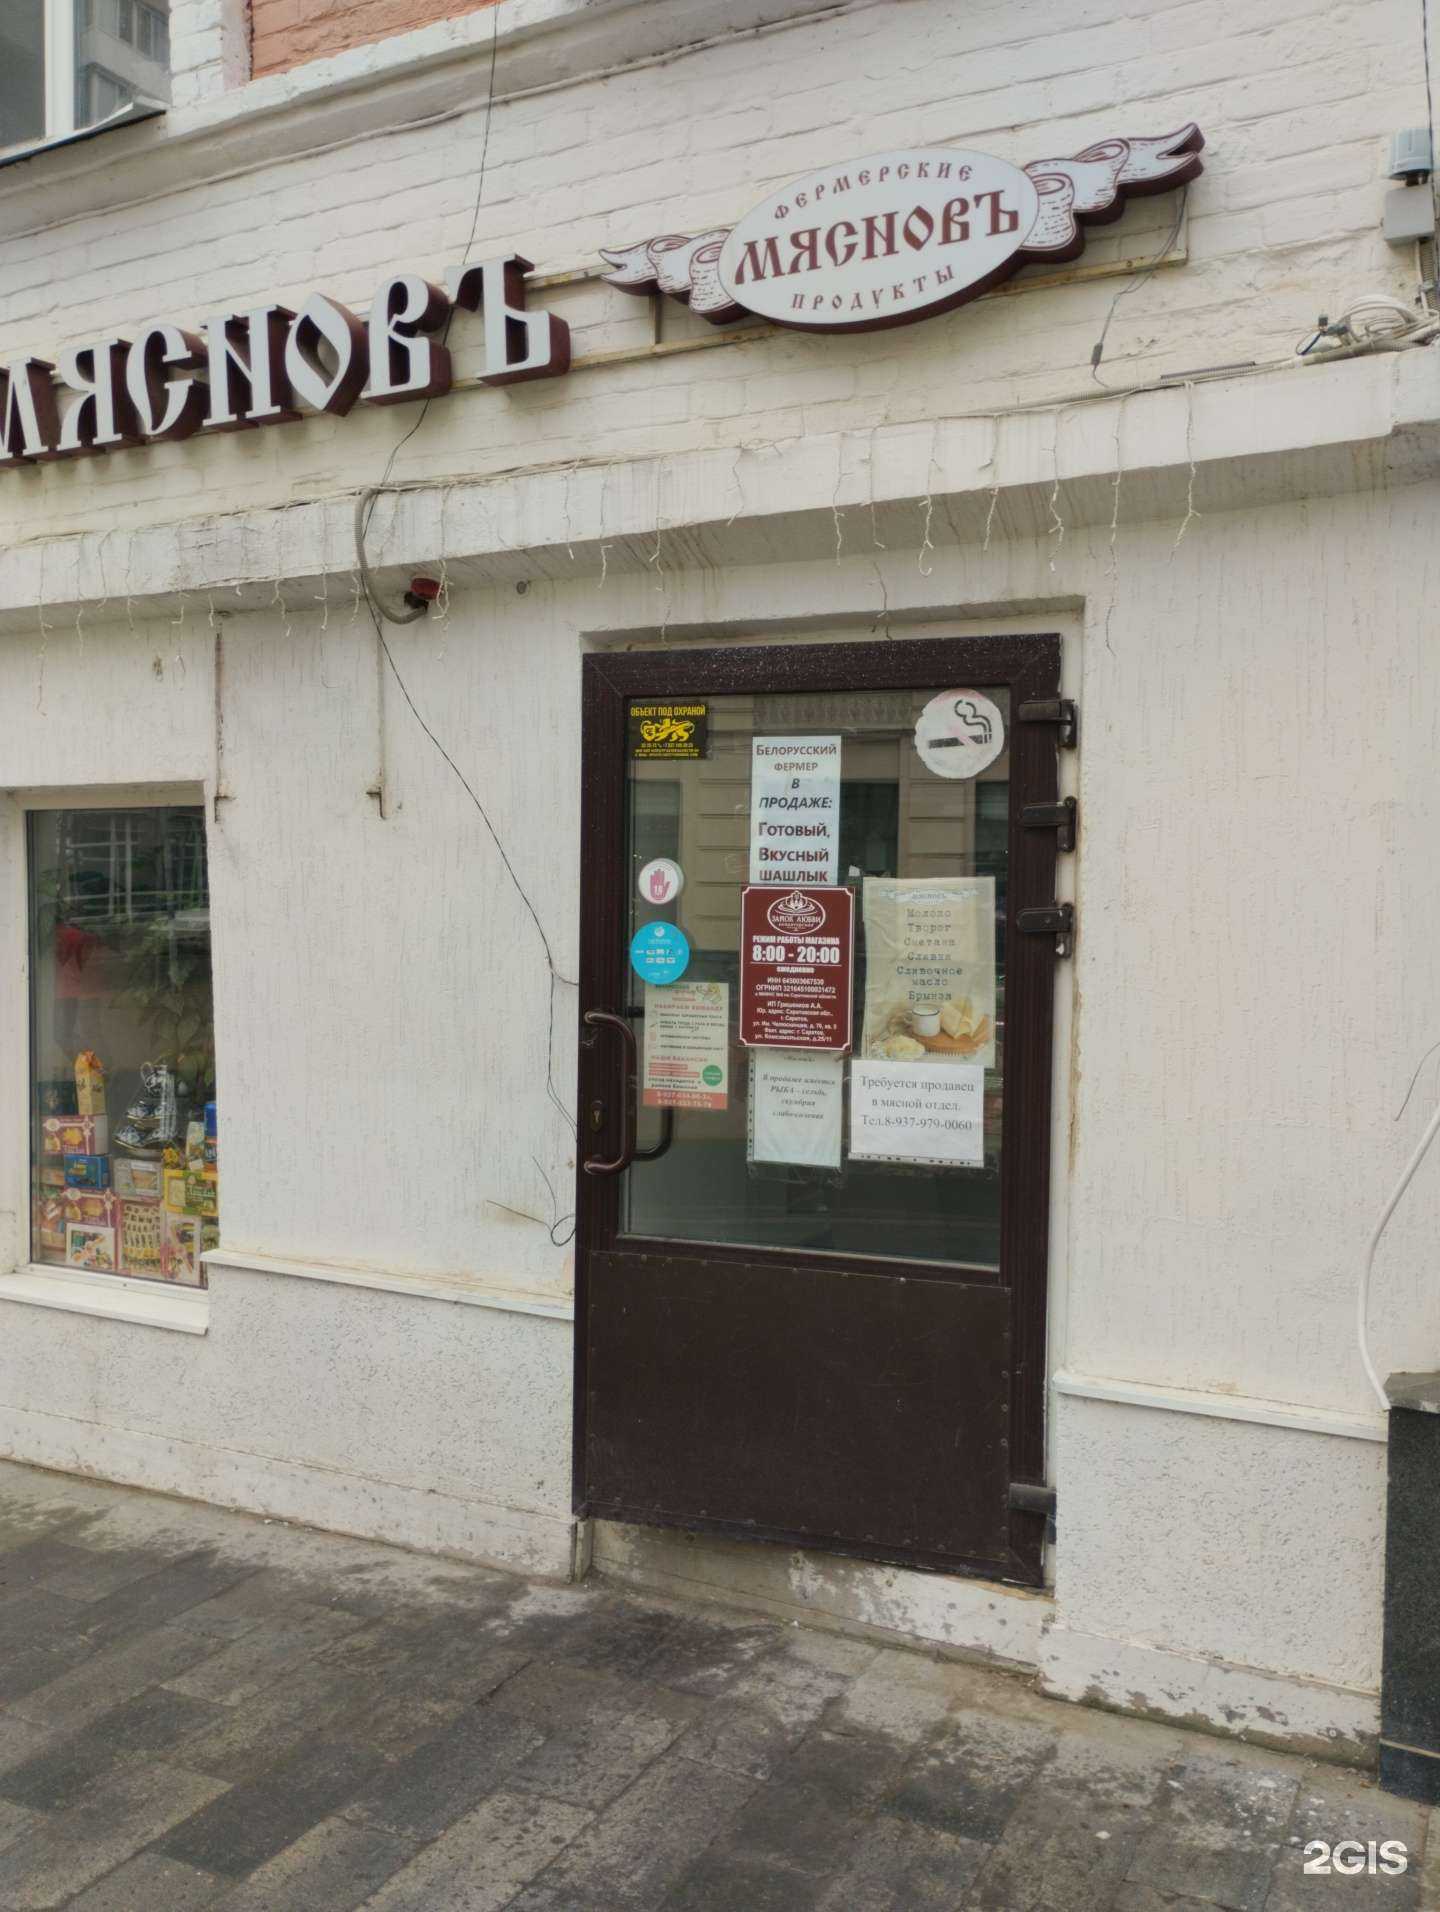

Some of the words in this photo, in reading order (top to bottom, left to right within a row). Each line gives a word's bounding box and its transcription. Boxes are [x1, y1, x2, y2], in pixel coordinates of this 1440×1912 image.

[774, 159, 974, 219] ФЕРМЕРСКИЕ
[734, 188, 1020, 286] МЯСНОВЪ
[791, 263, 955, 311] ПРОДУКТЫ
[630, 706, 657, 717] ОБЪЕКТ
[658, 706, 673, 718] ПОД
[674, 704, 706, 717] ОХРАНОЙ
[756, 744, 837, 756] БЕЛОРУССКИЙ
[774, 762, 818, 772] ФЕРМЕР
[759, 797, 832, 811] ПРОДАЖЕ:
[759, 847, 829, 862] ВКУСНЫЙ
[760, 870, 828, 882] ШАШЛЫК
[777, 936, 804, 944] РАБОТЫ
[805, 936, 840, 945] МАГАЗИНА
[752, 945, 785, 962] 8:00
[797, 946, 840, 963] 20:00
[860, 1075, 917, 1091] Требуется
